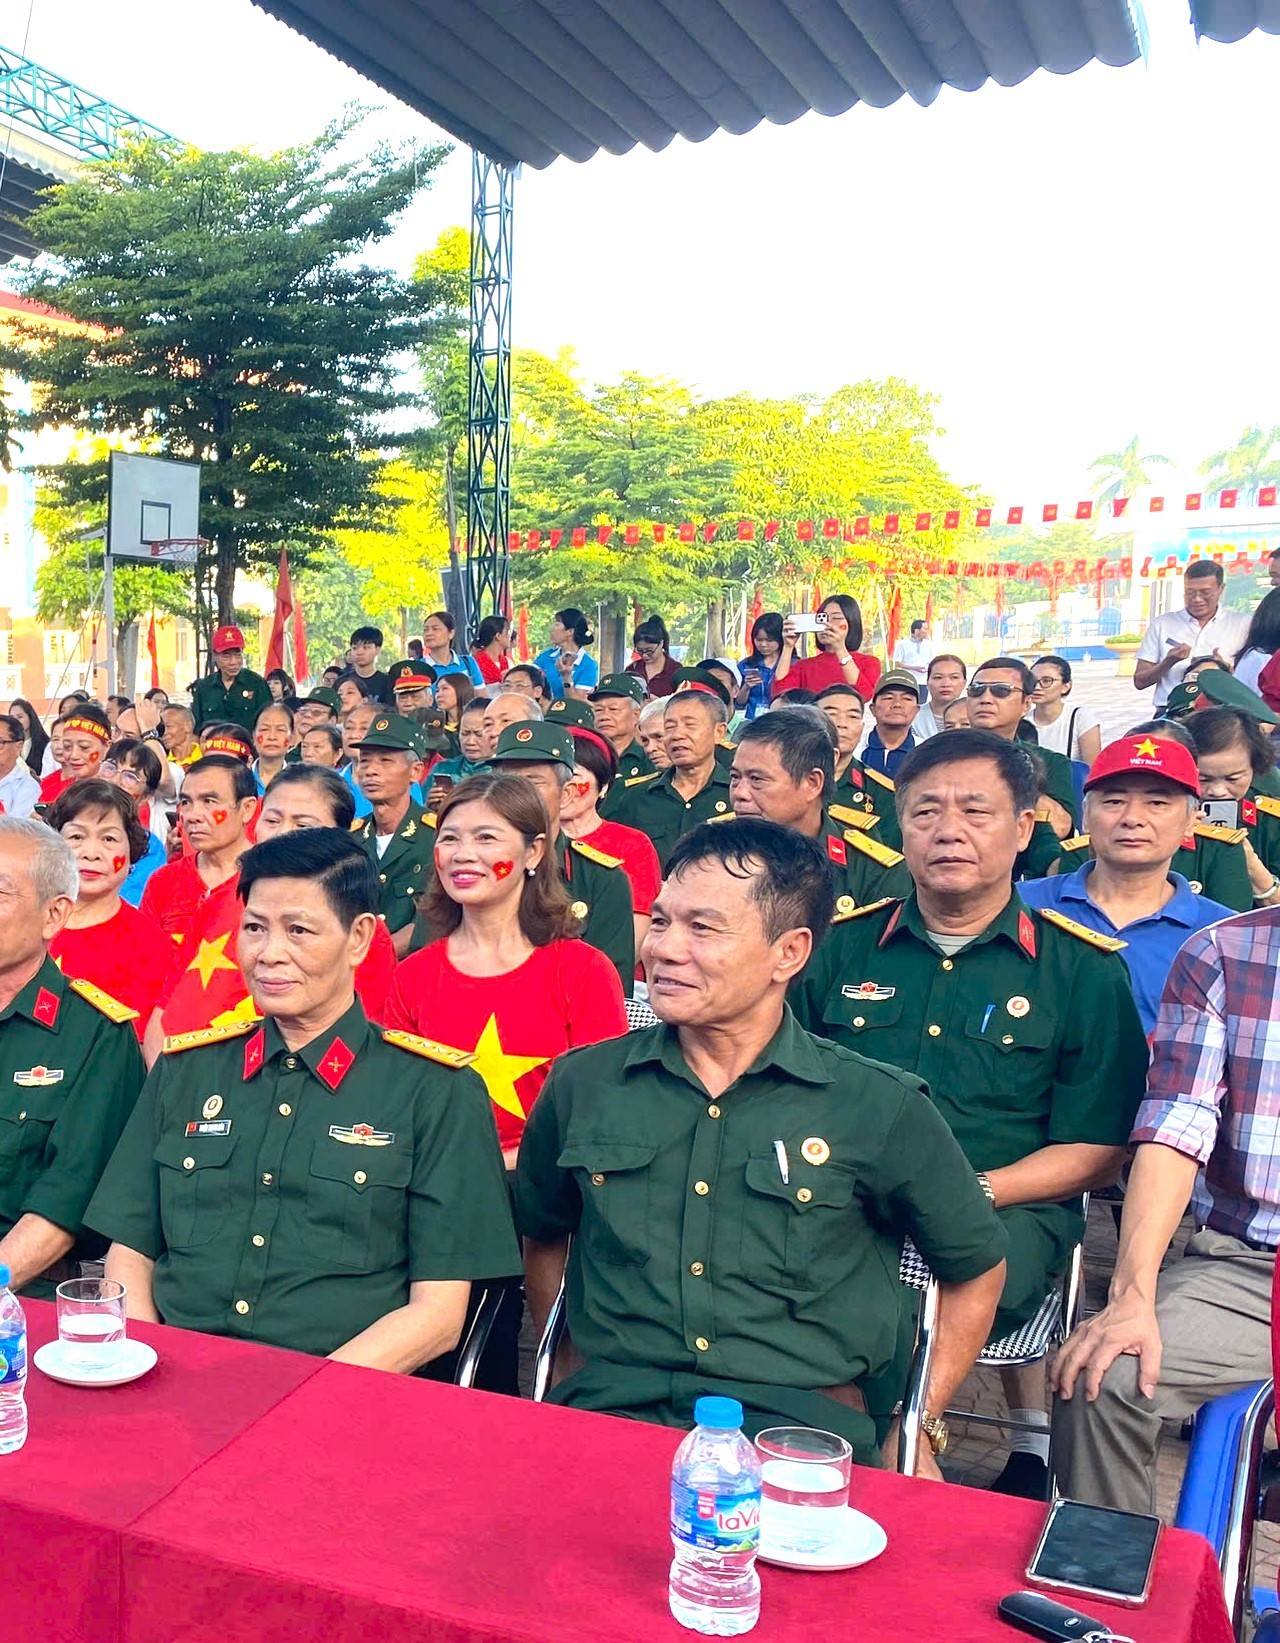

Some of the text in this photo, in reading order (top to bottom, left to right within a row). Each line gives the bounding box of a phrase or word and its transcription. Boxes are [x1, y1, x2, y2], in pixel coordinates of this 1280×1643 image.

[93, 724, 105, 737] NAM
[226, 741, 241, 752] NAM
[1129, 757, 1162, 767] VIỆT NAM
